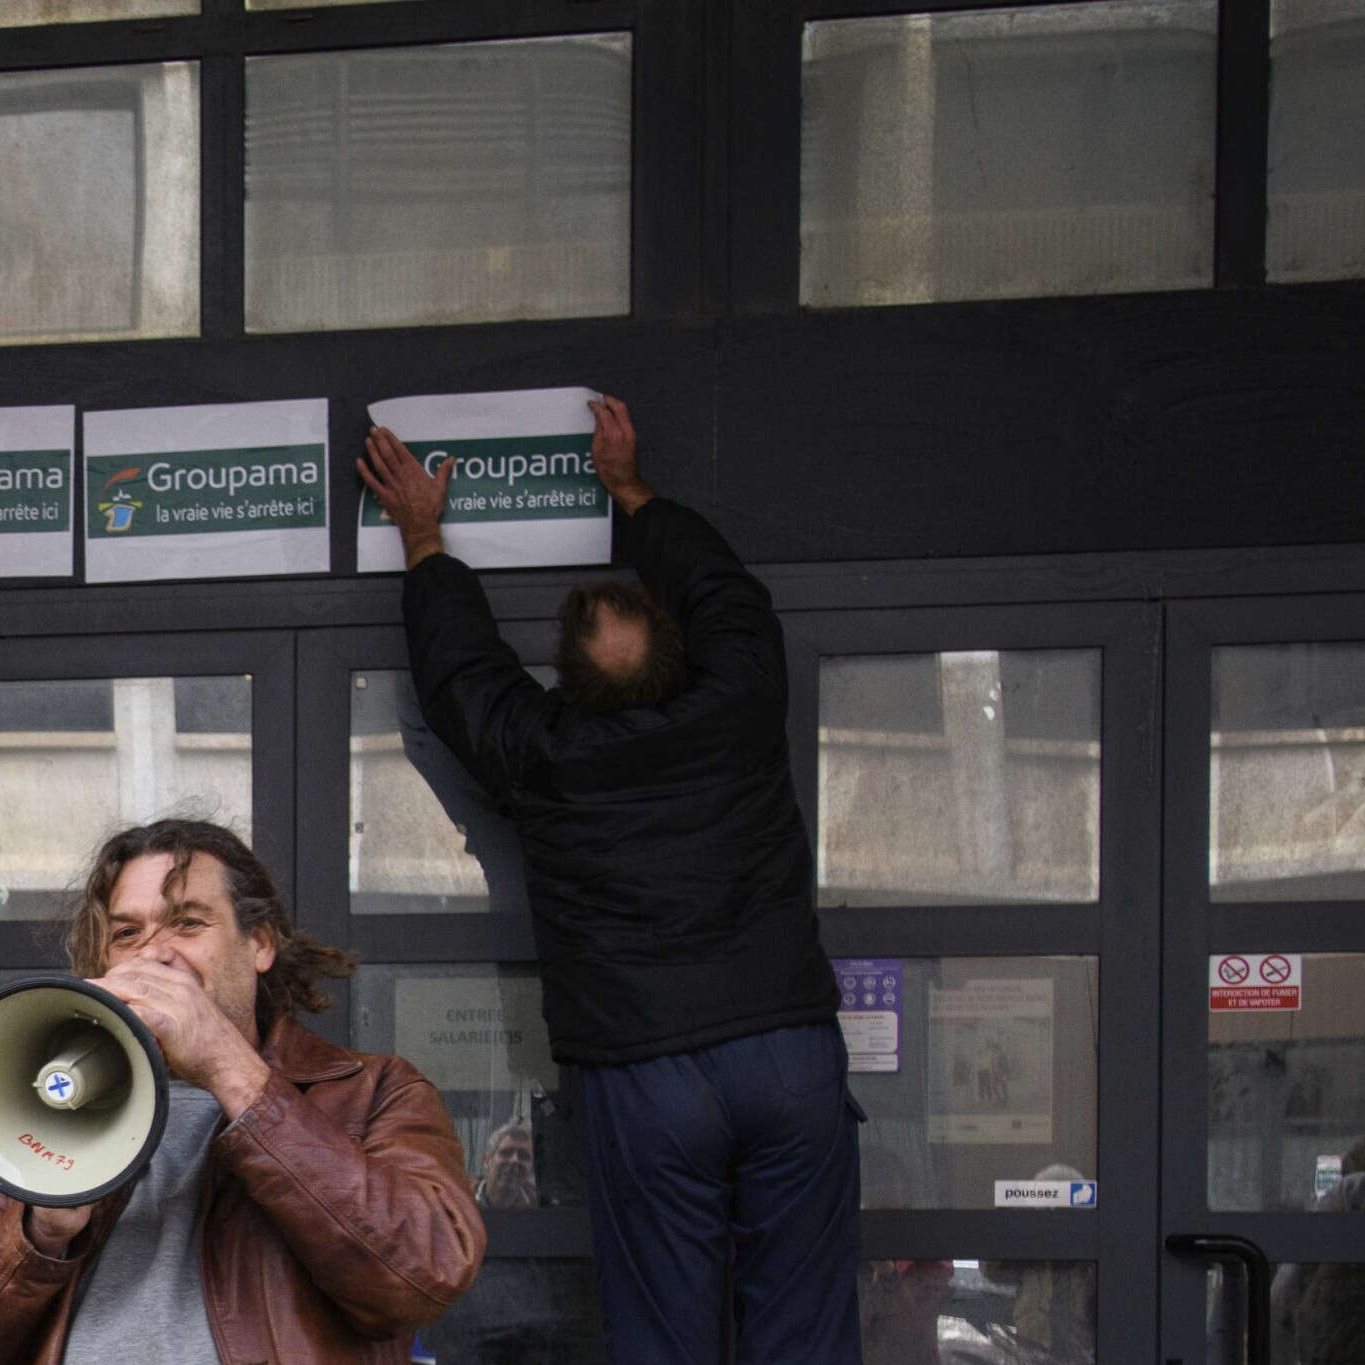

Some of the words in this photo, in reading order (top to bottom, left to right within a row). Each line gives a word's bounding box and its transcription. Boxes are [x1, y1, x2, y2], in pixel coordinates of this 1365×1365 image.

[147, 461, 319, 496] Groupama
[42, 501, 59, 520] ici
[156, 503, 169, 523] la
[172, 503, 209, 522] vraie
[213, 501, 233, 520] vie
[296, 496, 315, 516] ici
[449, 492, 486, 511] vraie
[490, 491, 512, 510] vie
[578, 487, 596, 507] ici
[1005, 1188, 1060, 1201] poussez
